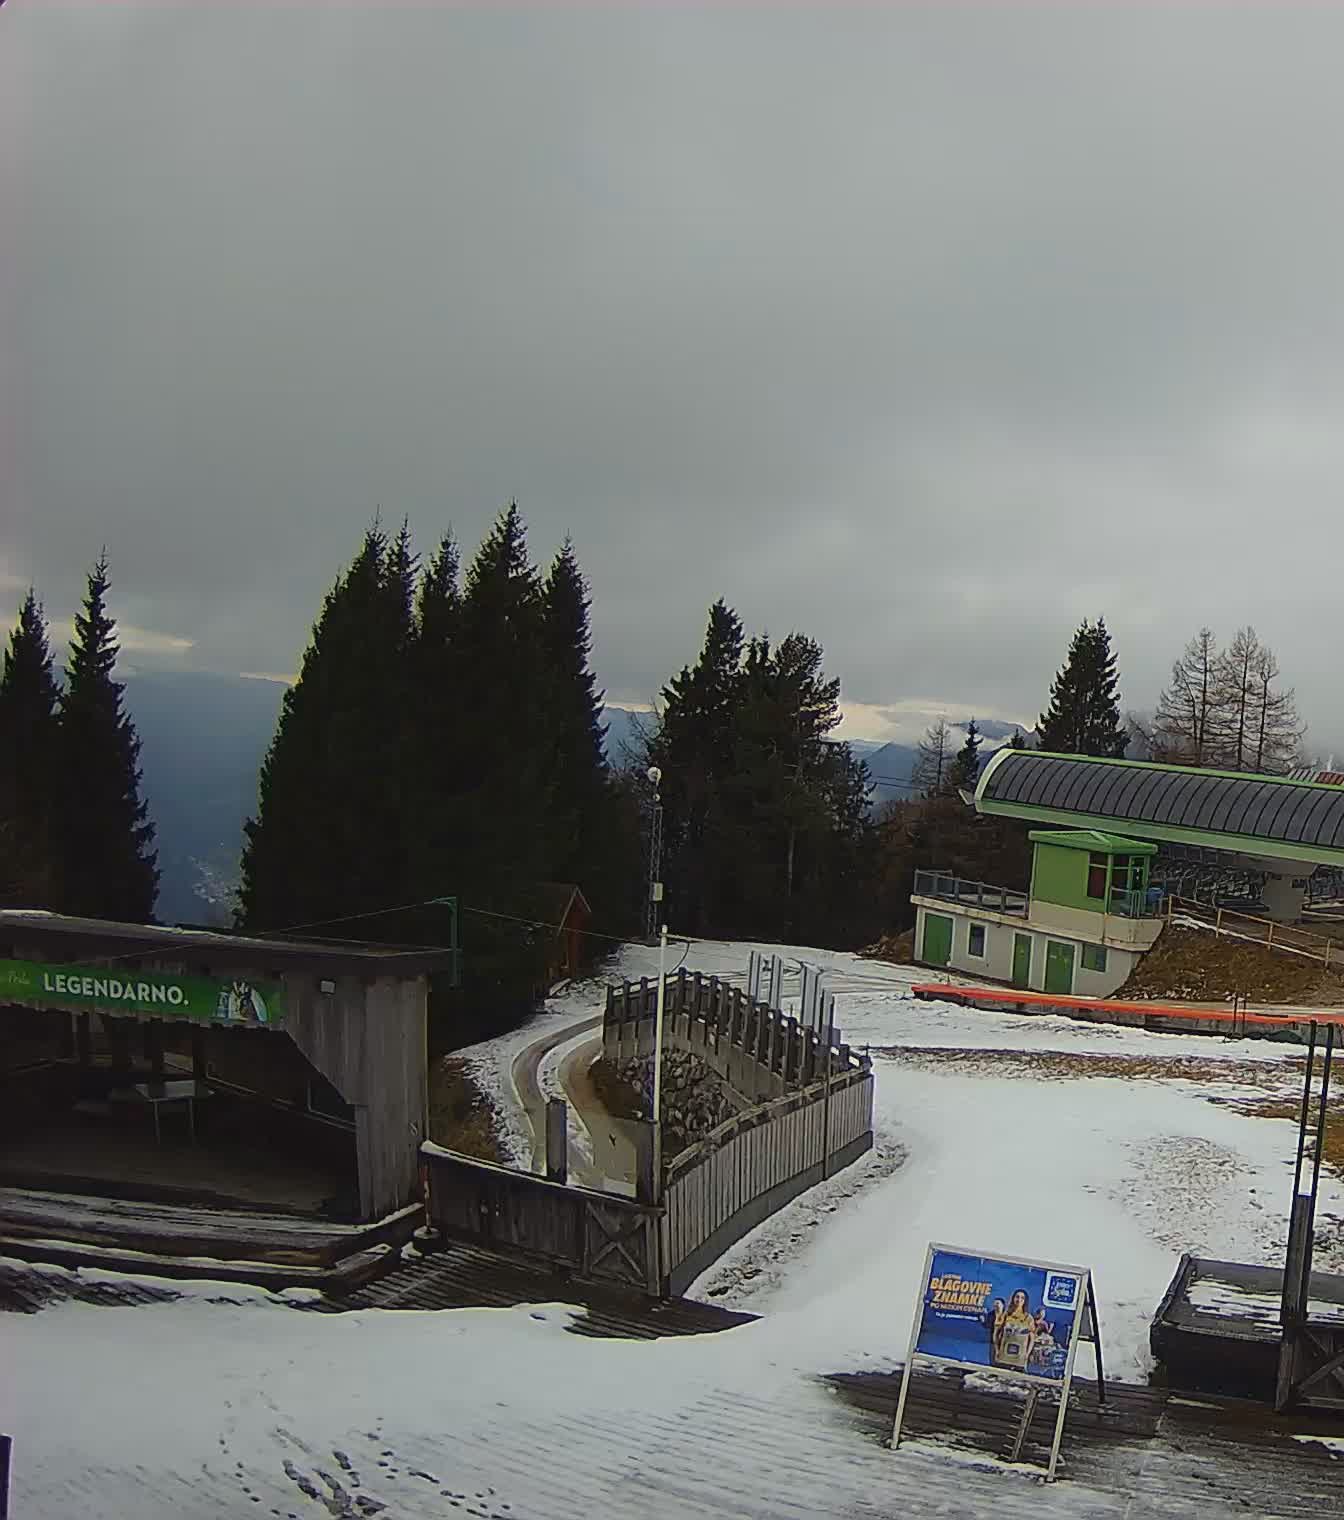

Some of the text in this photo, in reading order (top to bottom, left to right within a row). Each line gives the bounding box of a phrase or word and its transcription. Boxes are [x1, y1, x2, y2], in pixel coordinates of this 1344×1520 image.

[43, 973, 189, 1006] LEGENDARNO.
[930, 1277, 993, 1296] BLAGOVNE
[933, 1290, 986, 1307] ZNAMKE
